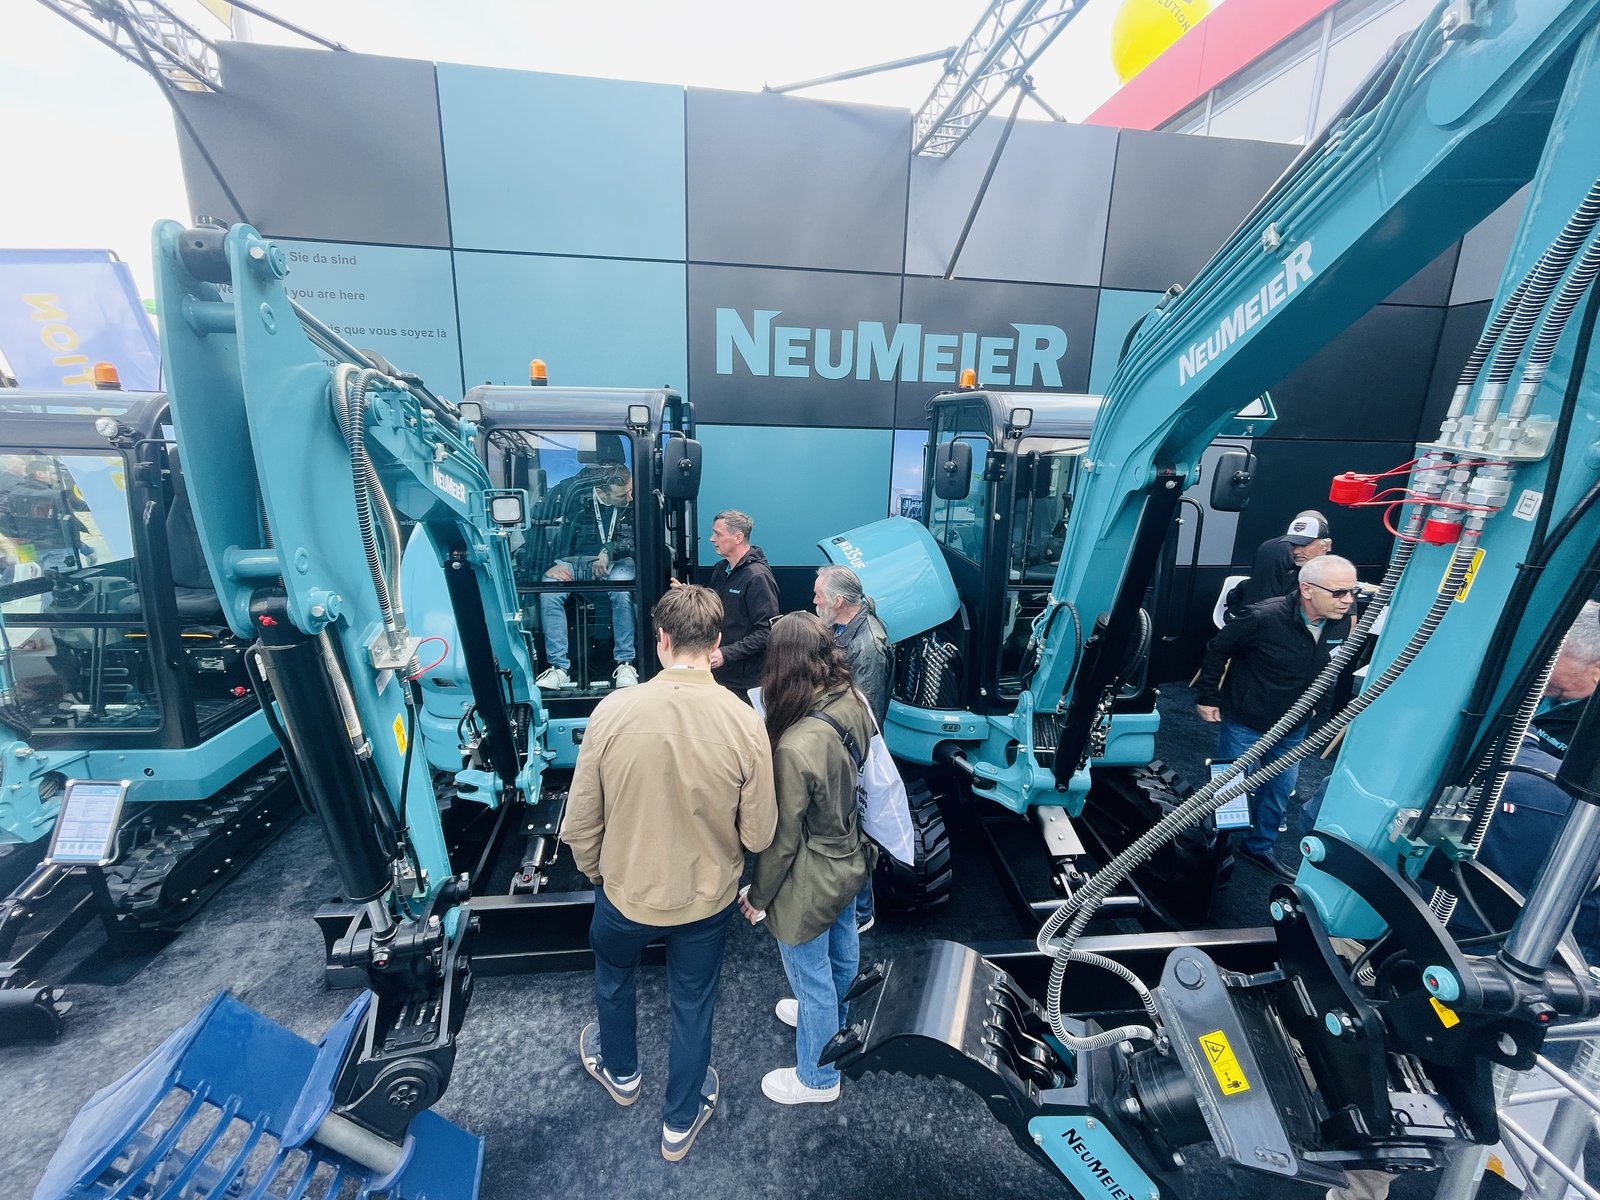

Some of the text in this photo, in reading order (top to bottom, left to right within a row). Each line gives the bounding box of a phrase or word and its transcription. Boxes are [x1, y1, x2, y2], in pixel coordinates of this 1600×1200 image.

[289, 251, 357, 265] Sie da sind
[290, 289, 314, 300] you
[318, 290, 336, 299] are
[339, 289, 366, 301] here
[344, 325, 366, 336] que
[368, 327, 397, 336] vous
[400, 328, 434, 339] soyez
[436, 328, 447, 338] là
[716, 307, 1068, 388] NEUMEIER
[1061, 1128, 1136, 1200] NEUMEIE
